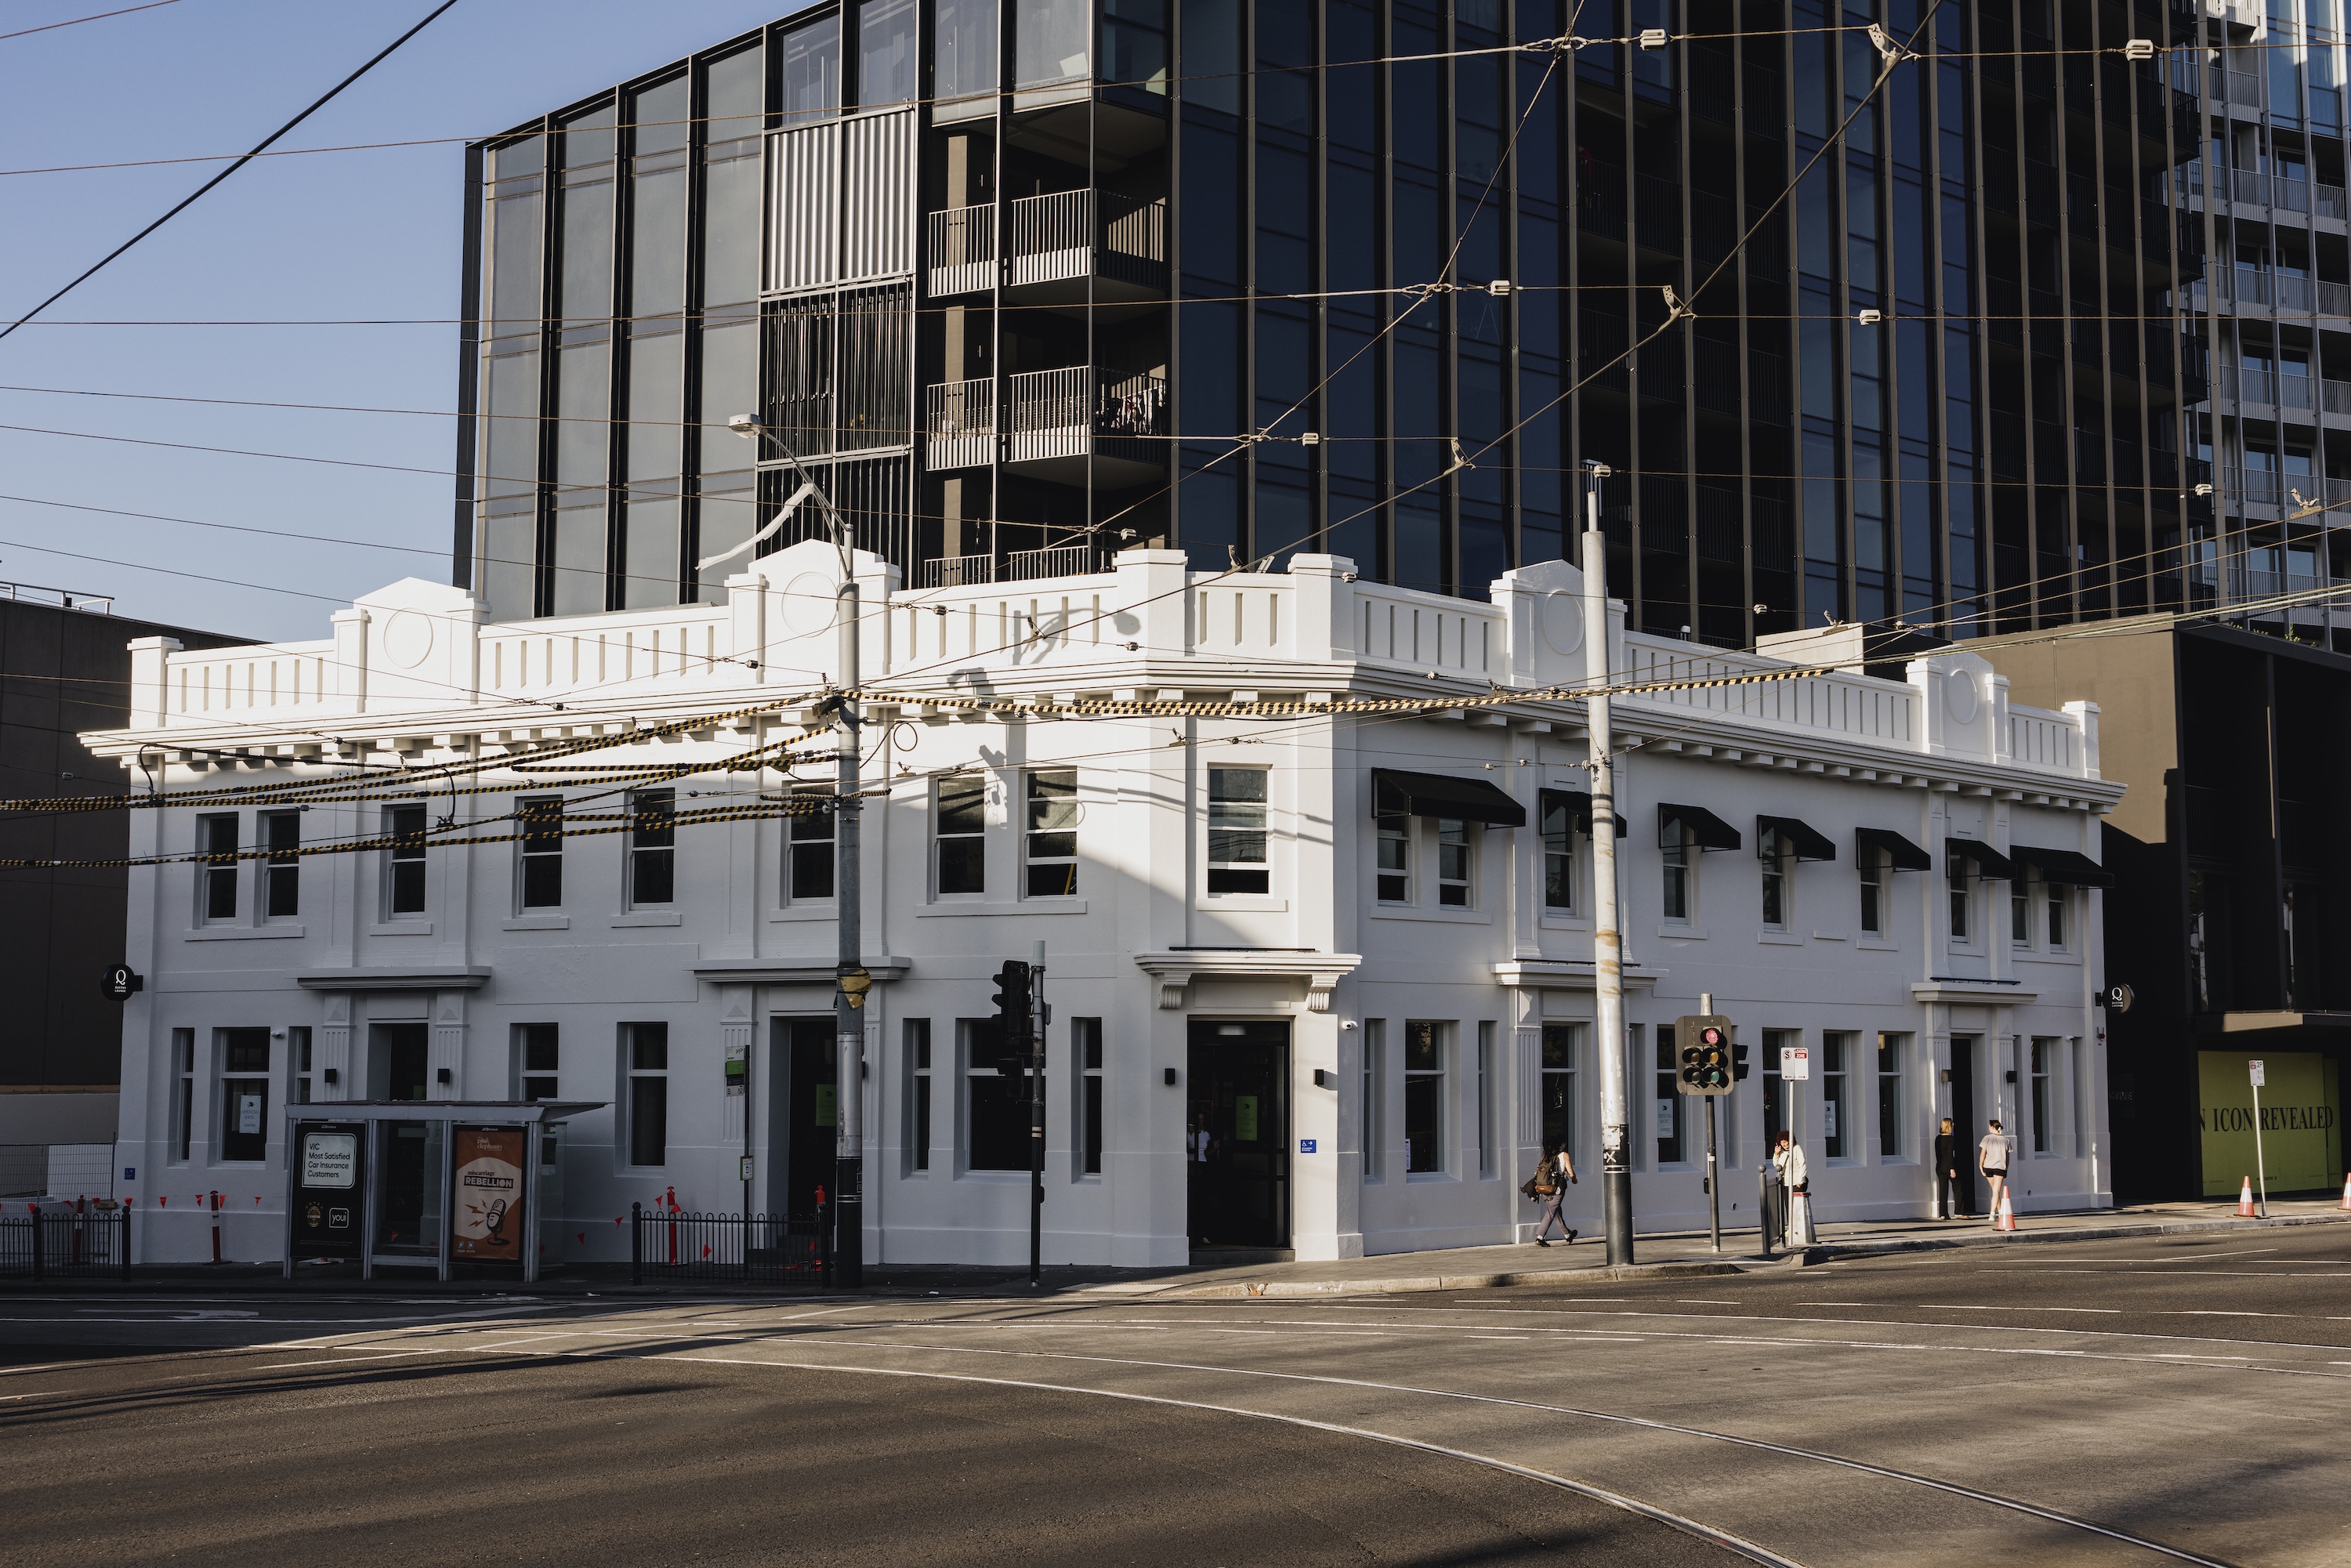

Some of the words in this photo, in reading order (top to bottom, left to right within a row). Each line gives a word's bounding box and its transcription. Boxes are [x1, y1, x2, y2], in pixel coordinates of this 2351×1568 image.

[115, 969, 126, 986] Q
[2111, 987, 2123, 1001] Q
[2213, 1107, 2253, 1132] ICON
[2260, 1106, 2333, 1131] REVEALED
[465, 1176, 513, 1188] REBELLION
[331, 1211, 346, 1224] youi
